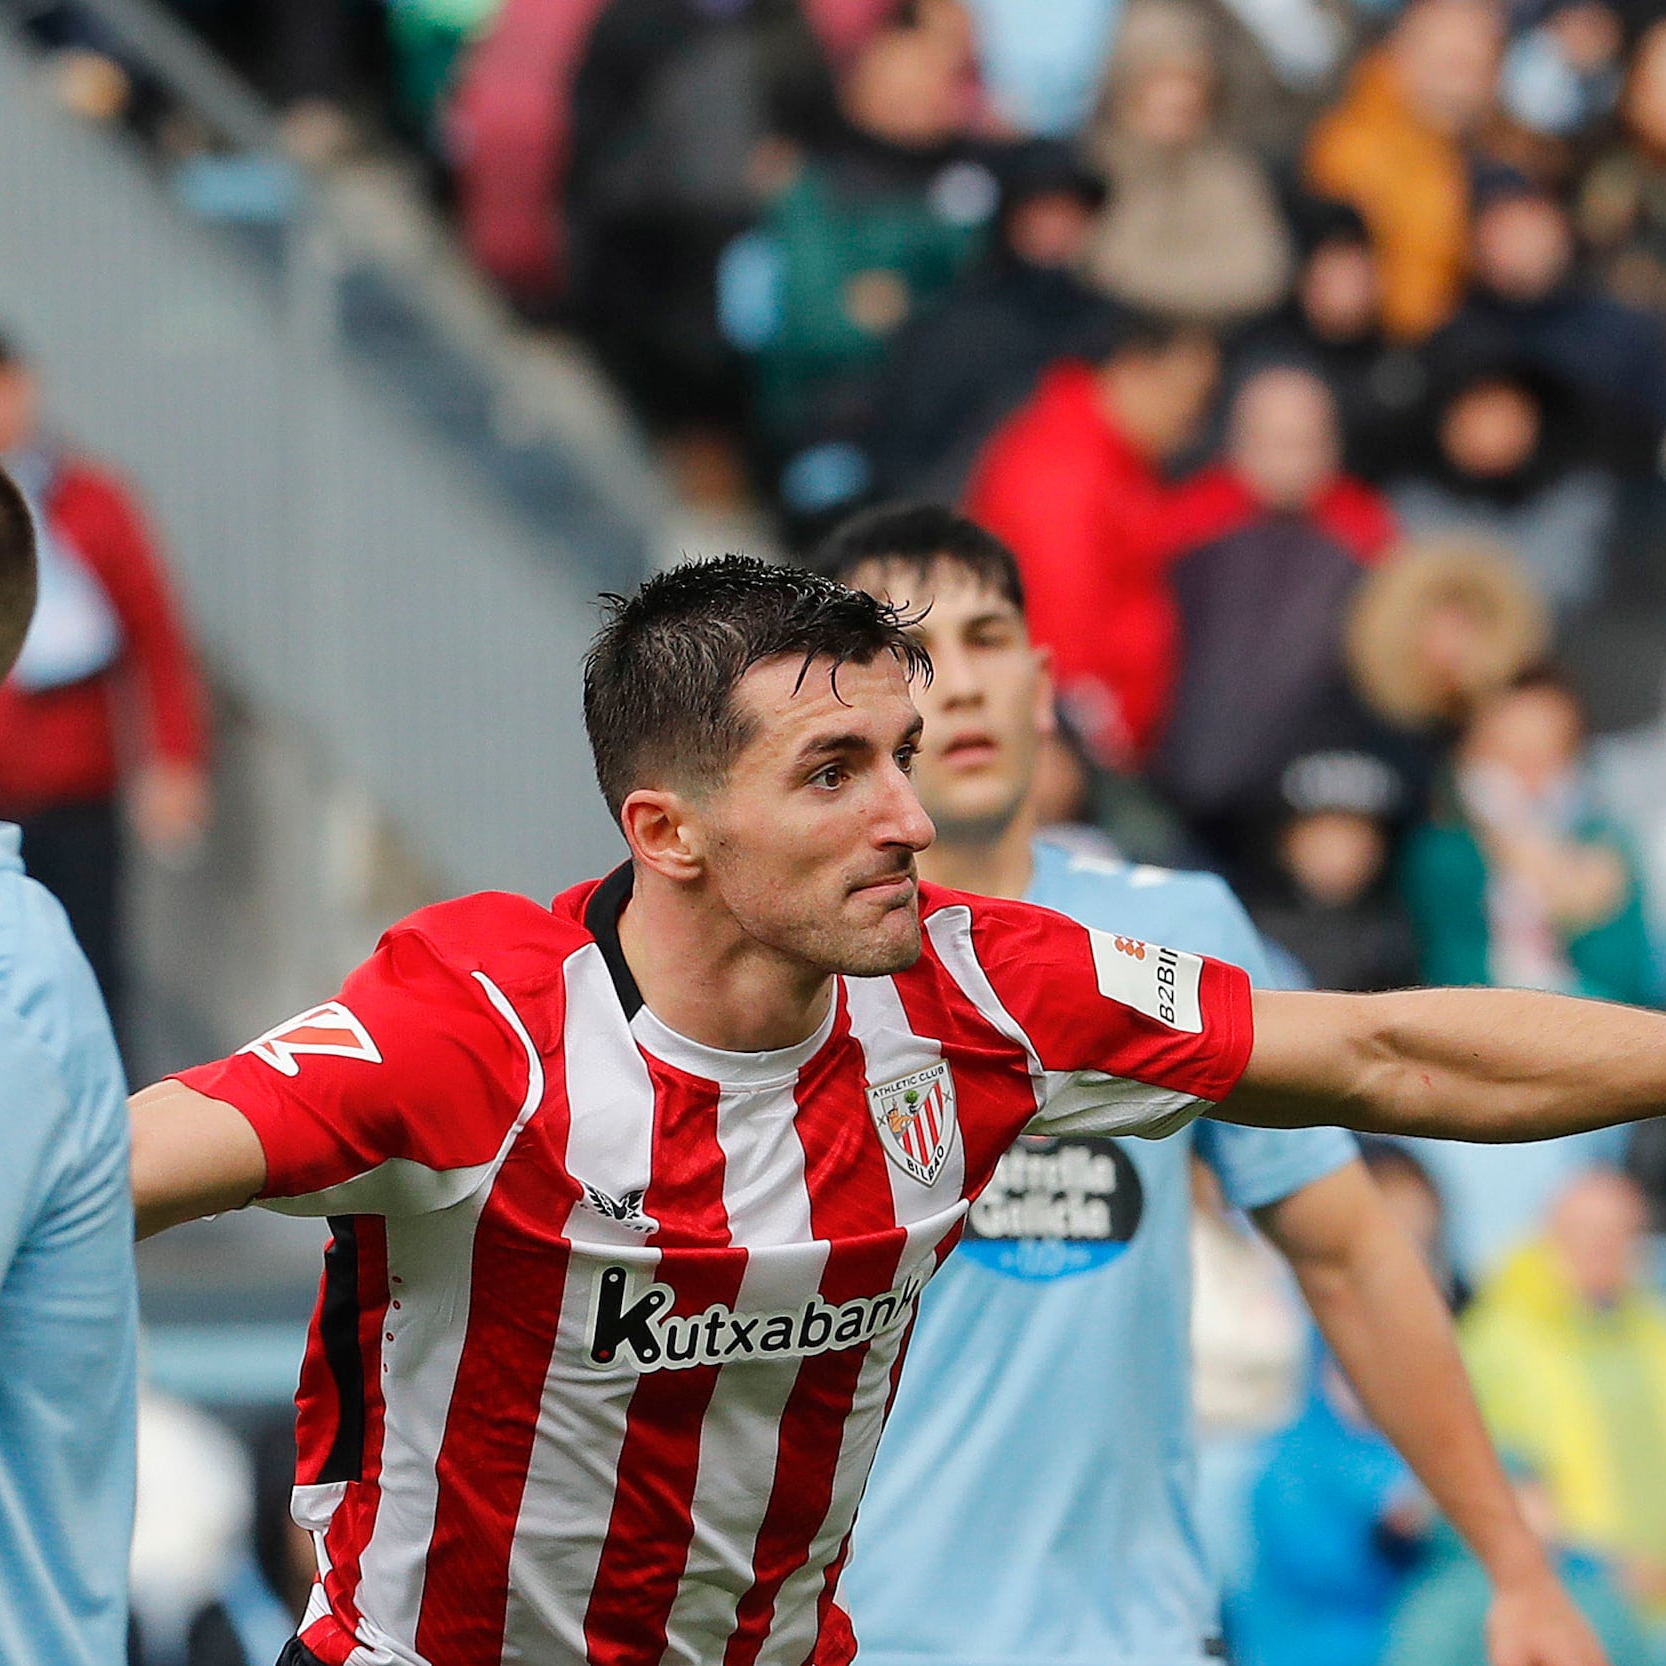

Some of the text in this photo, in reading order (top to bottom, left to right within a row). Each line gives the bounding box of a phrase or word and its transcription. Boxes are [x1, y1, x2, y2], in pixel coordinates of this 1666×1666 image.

[872, 1065, 945, 1099] ATHLETIC CLUB
[905, 1144, 945, 1181] BILBAO
[994, 1147, 1117, 1196] strella
[590, 1265, 924, 1364] Kutxabank
